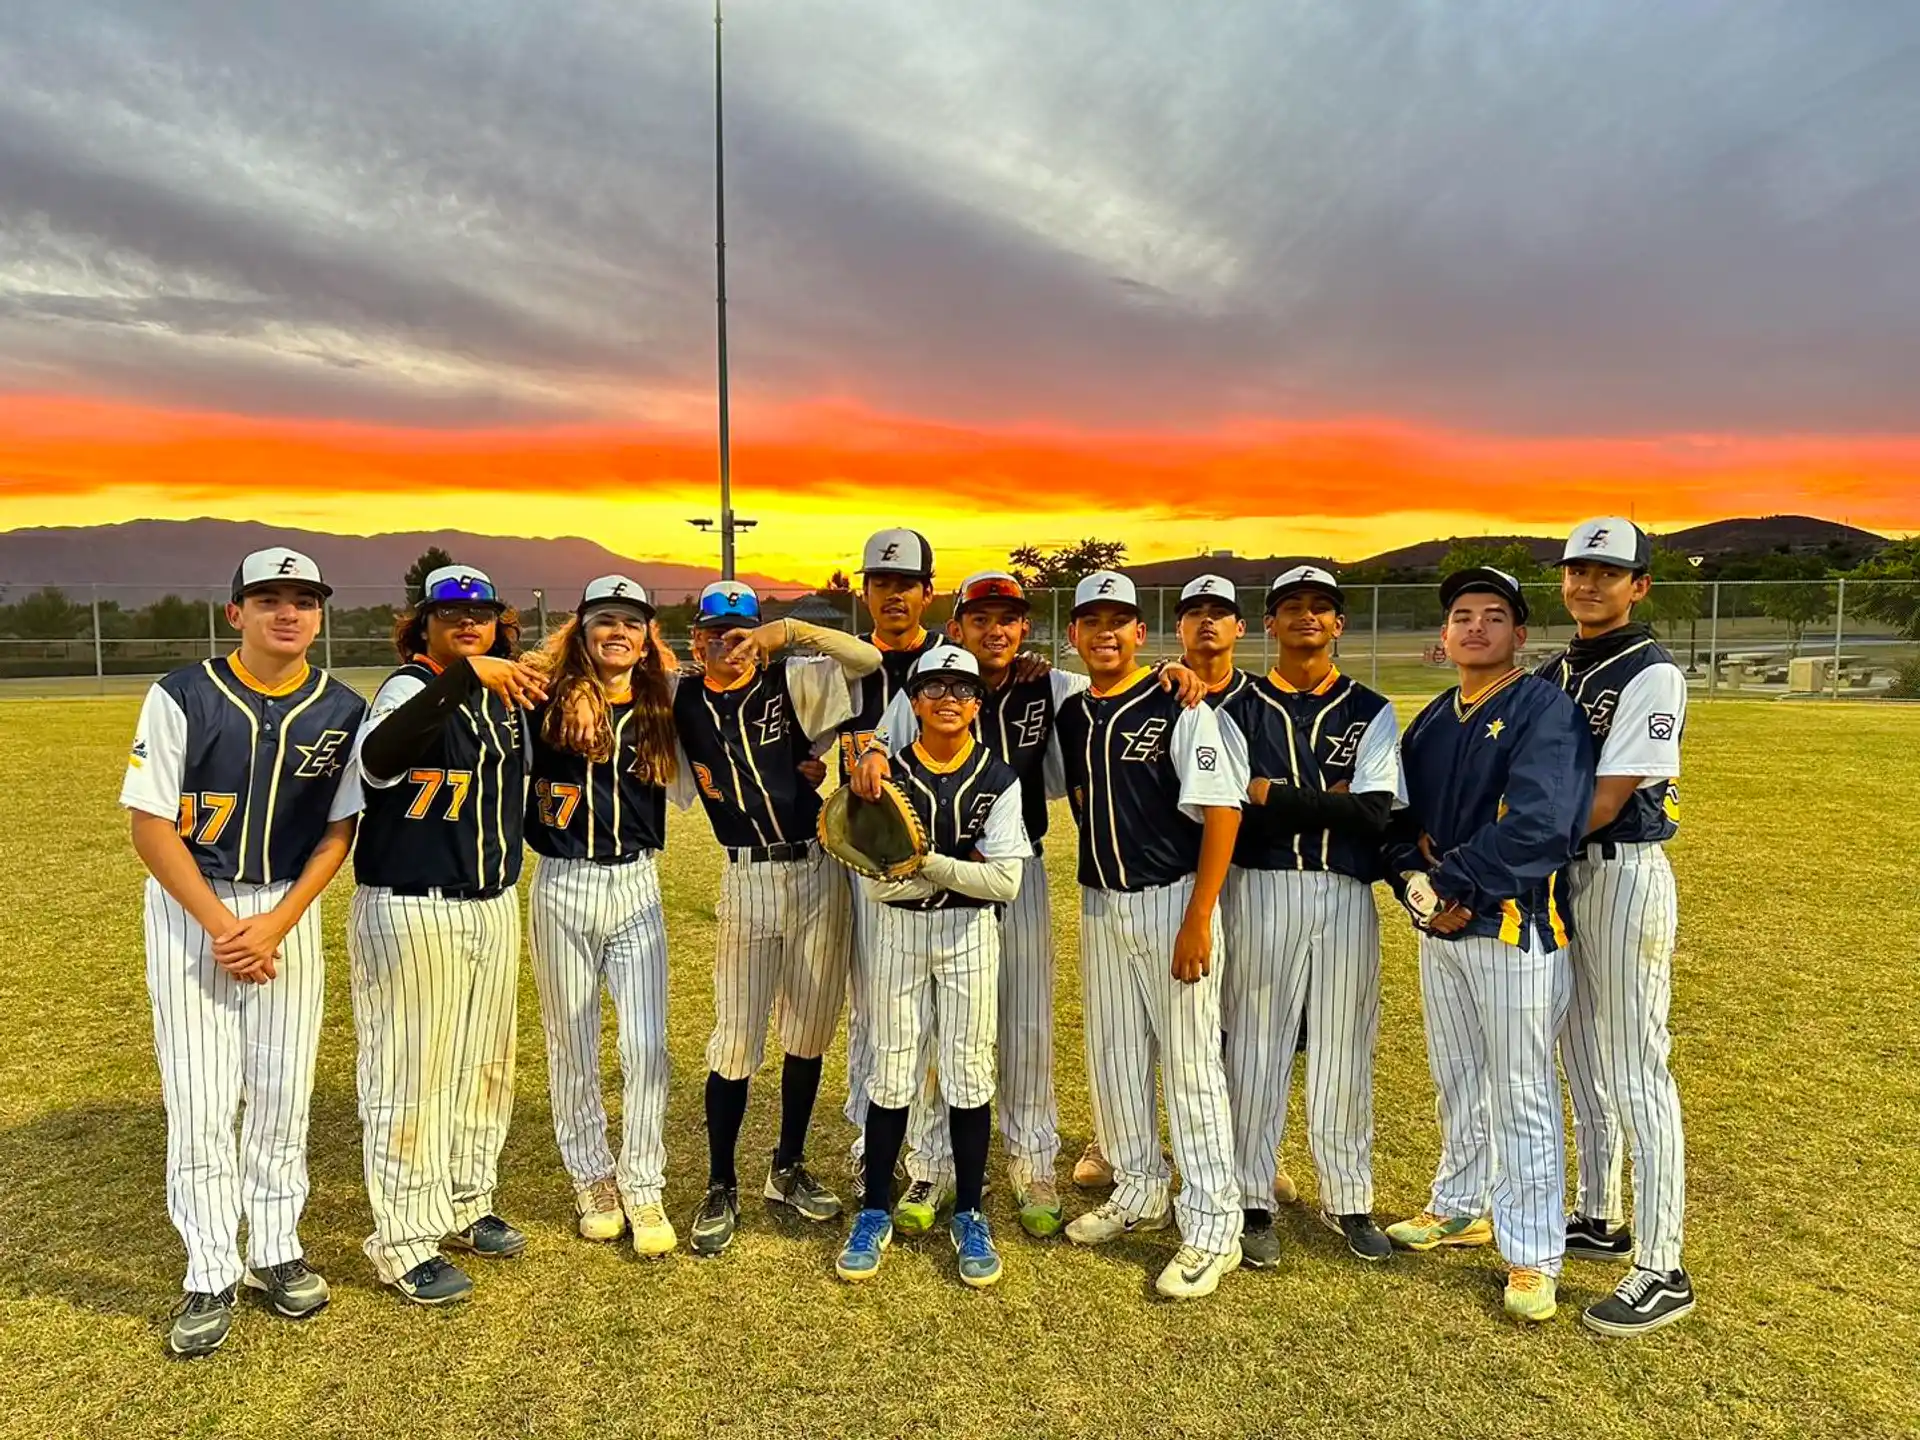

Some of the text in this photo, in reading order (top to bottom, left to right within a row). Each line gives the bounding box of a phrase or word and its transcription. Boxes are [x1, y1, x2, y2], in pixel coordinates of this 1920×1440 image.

[1585, 530, 1609, 548] E
[881, 543, 899, 561] E
[277, 557, 297, 575] E
[611, 582, 628, 597] E
[1097, 579, 1116, 595] E
[1200, 579, 1214, 593] E
[940, 653, 959, 668] E
[1011, 699, 1047, 748] E
[1120, 718, 1168, 761] E
[294, 729, 349, 777] E
[404, 768, 473, 822] 77
[535, 778, 582, 830] 27
